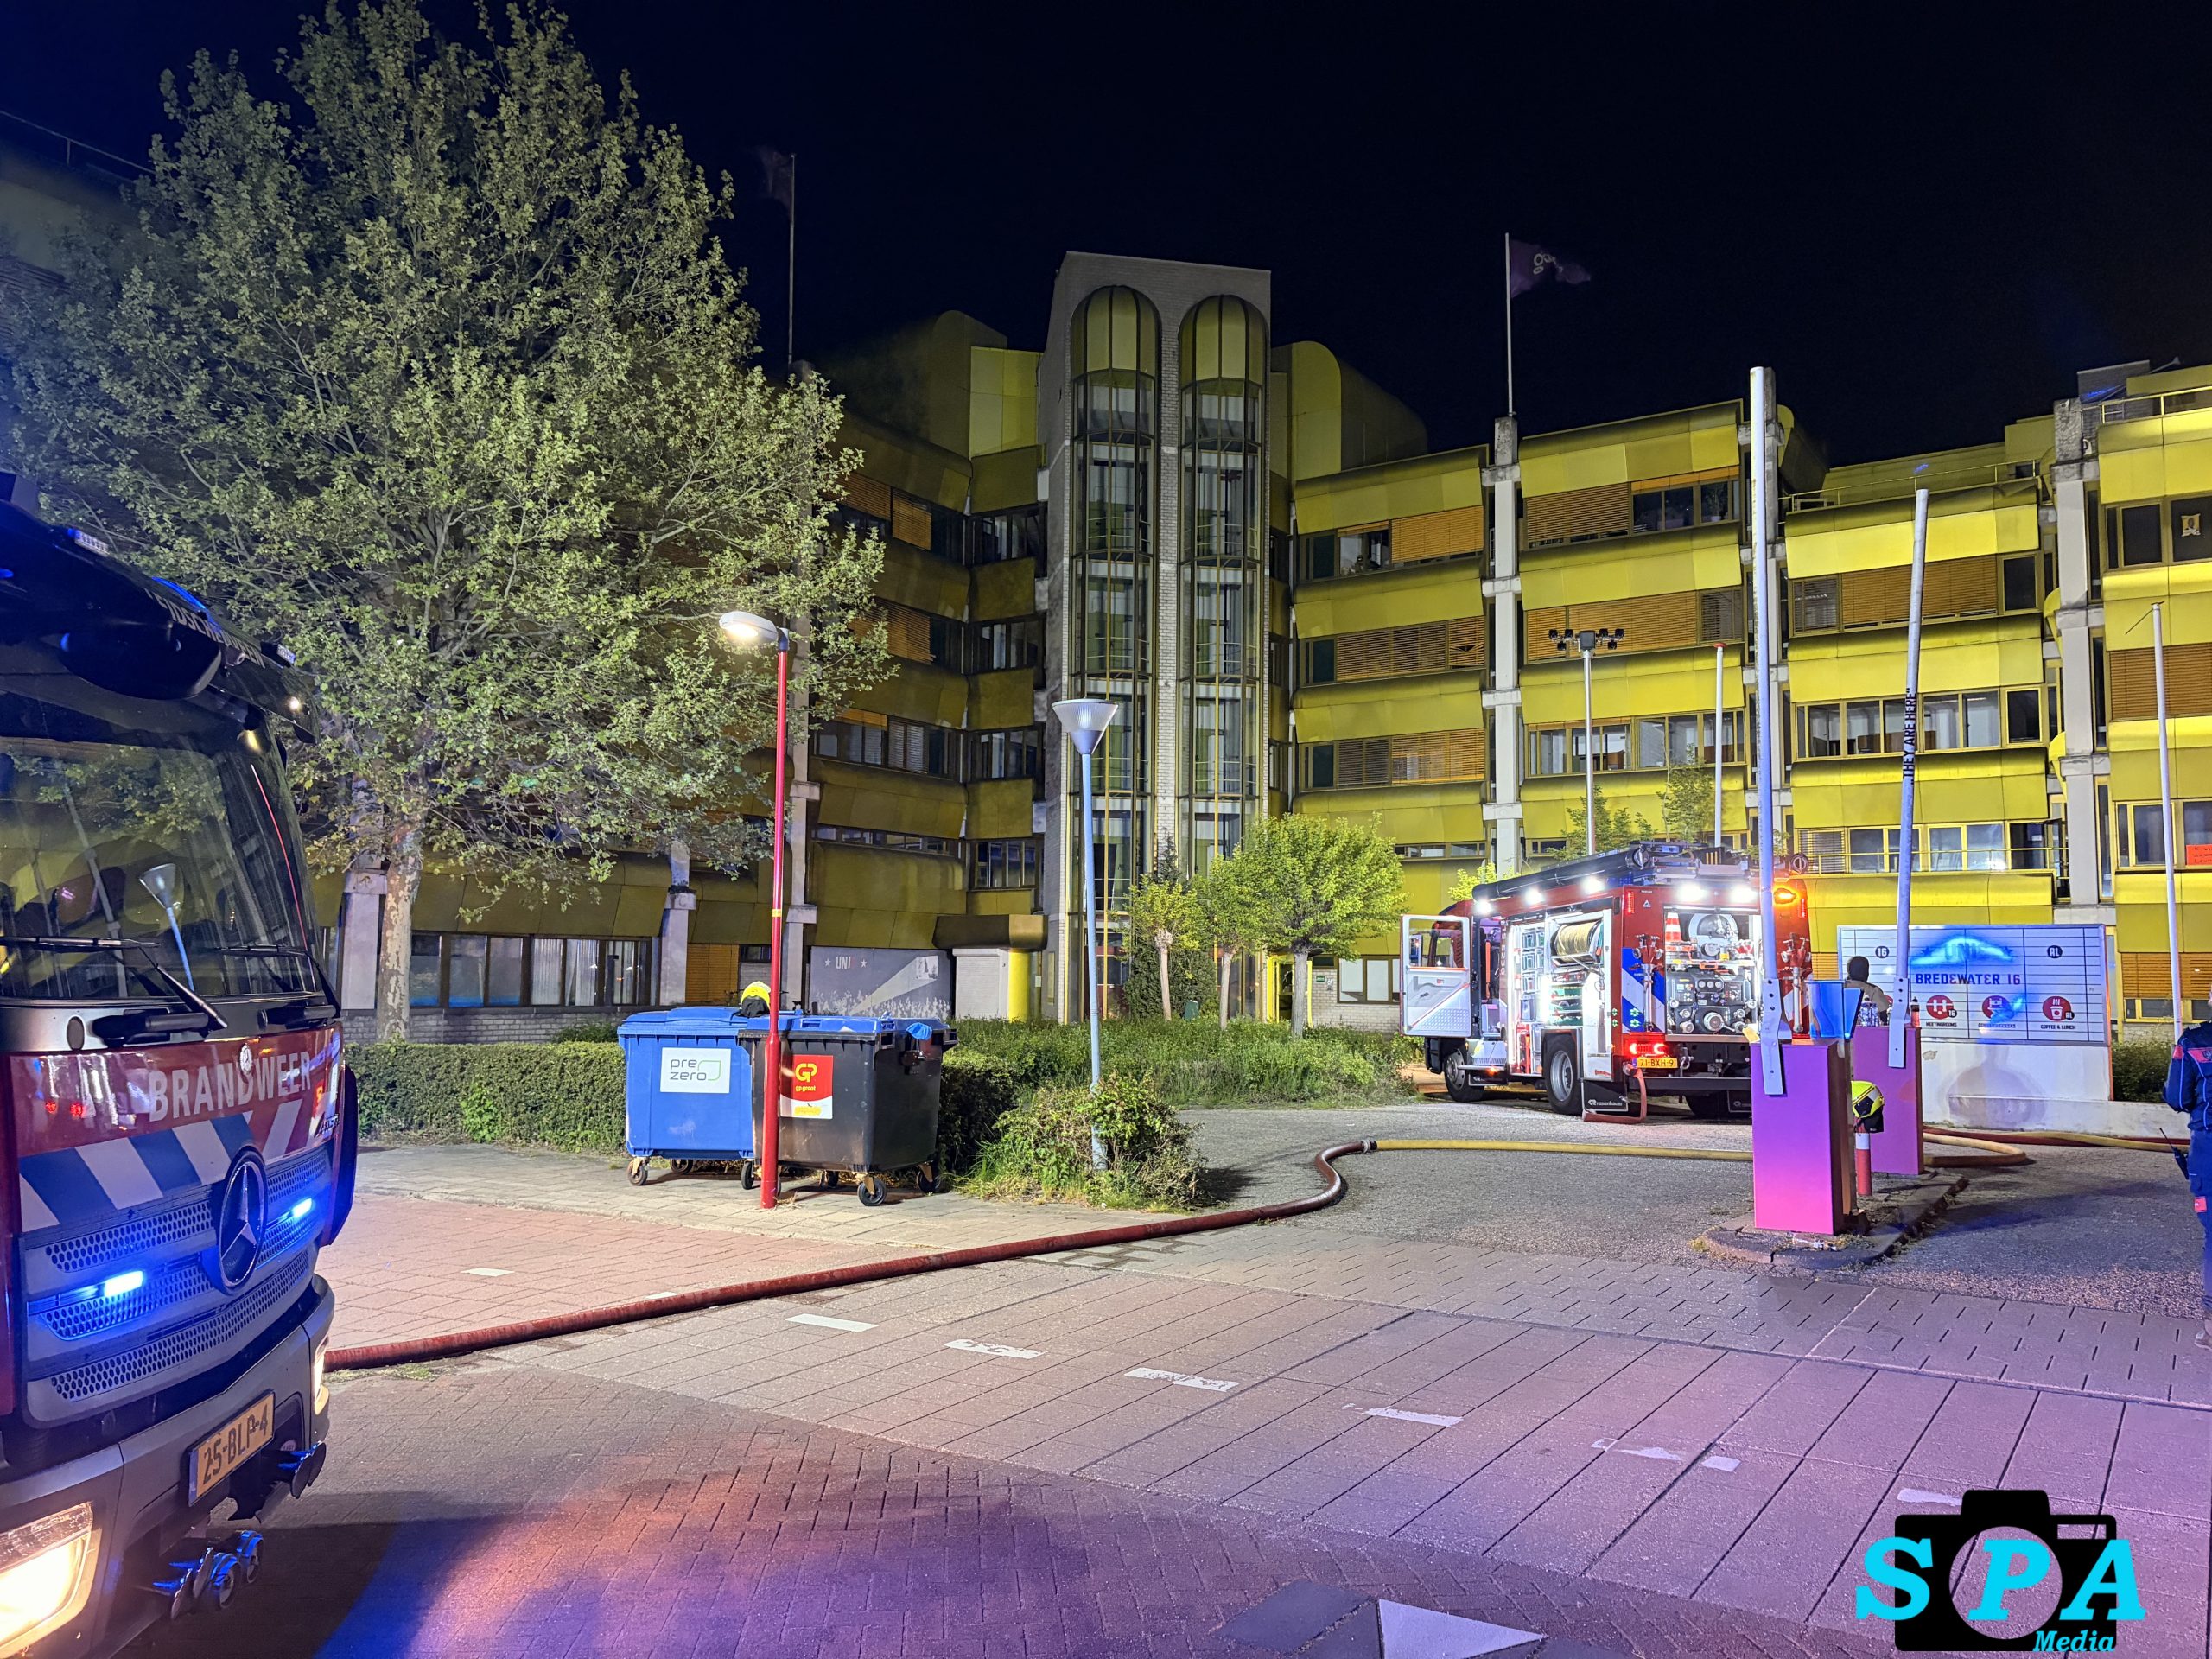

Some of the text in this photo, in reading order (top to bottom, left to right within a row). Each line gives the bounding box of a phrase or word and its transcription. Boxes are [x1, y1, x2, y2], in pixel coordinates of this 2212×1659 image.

[1904, 723, 1916, 746] ARE
[1877, 947, 1888, 957] 16
[1916, 973, 2021, 985] BREDEWATER 16
[670, 1058, 697, 1071] pre
[1639, 1058, 1675, 1067] 71-BXH-9
[670, 1071, 707, 1081] zero
[149, 1051, 311, 1122] BRANDWEER
[203, 1403, 269, 1485] 25-BLP-4
